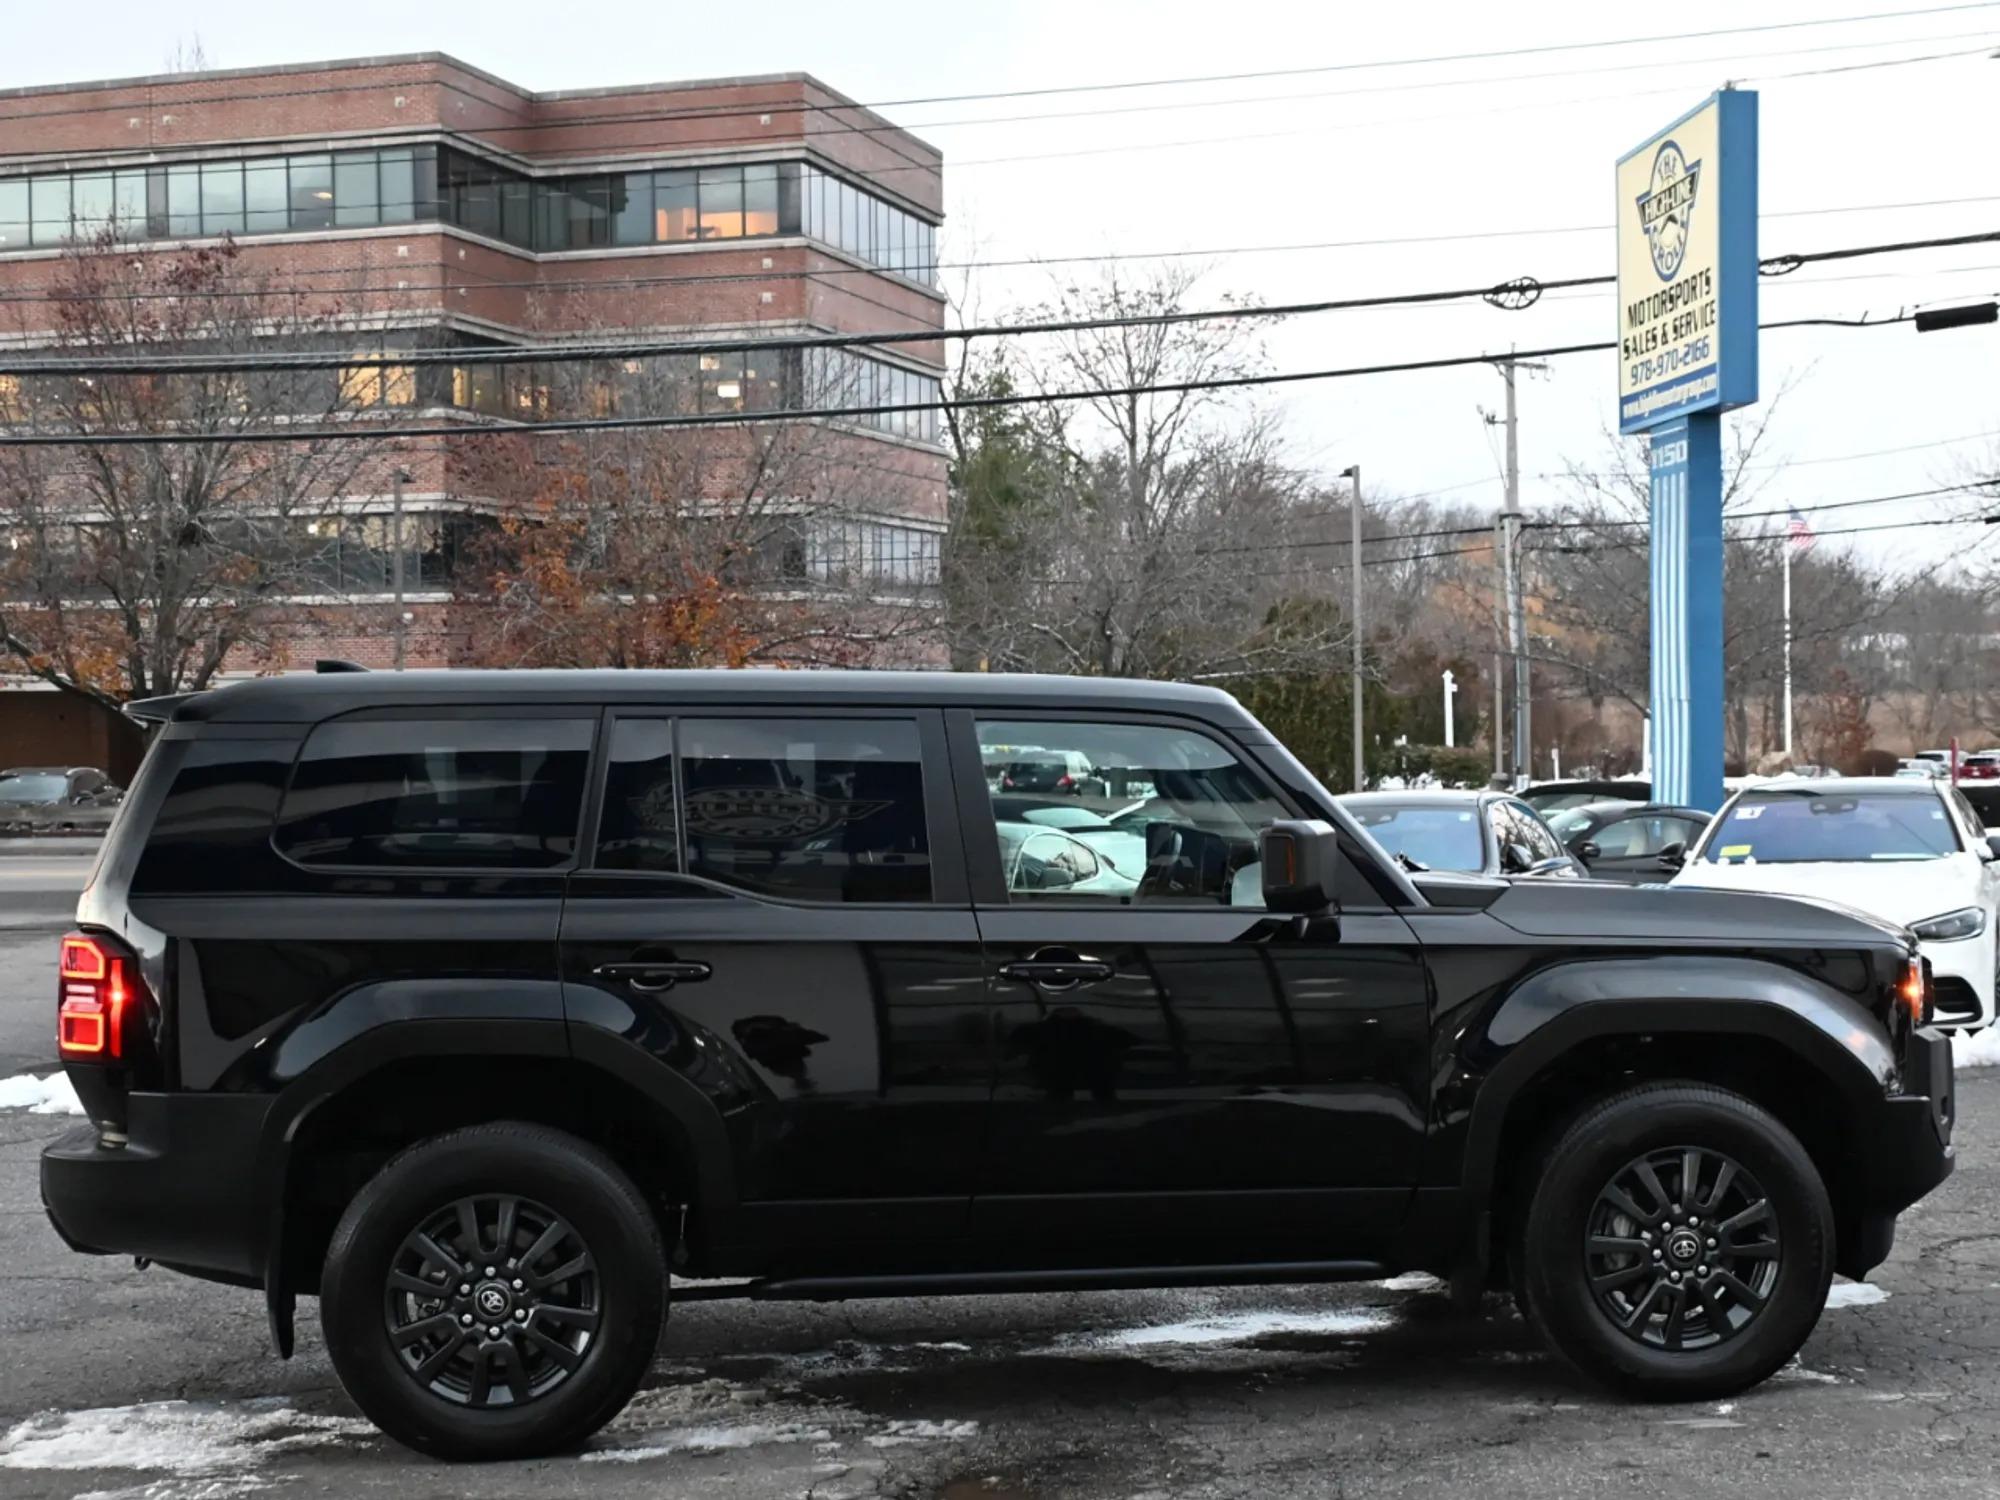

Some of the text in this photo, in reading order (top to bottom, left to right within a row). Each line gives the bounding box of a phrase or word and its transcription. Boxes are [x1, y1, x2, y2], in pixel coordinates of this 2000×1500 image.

[1628, 267, 1711, 329] MOTORSPORTS
[1624, 300, 1716, 361] SALES & SERVICE
